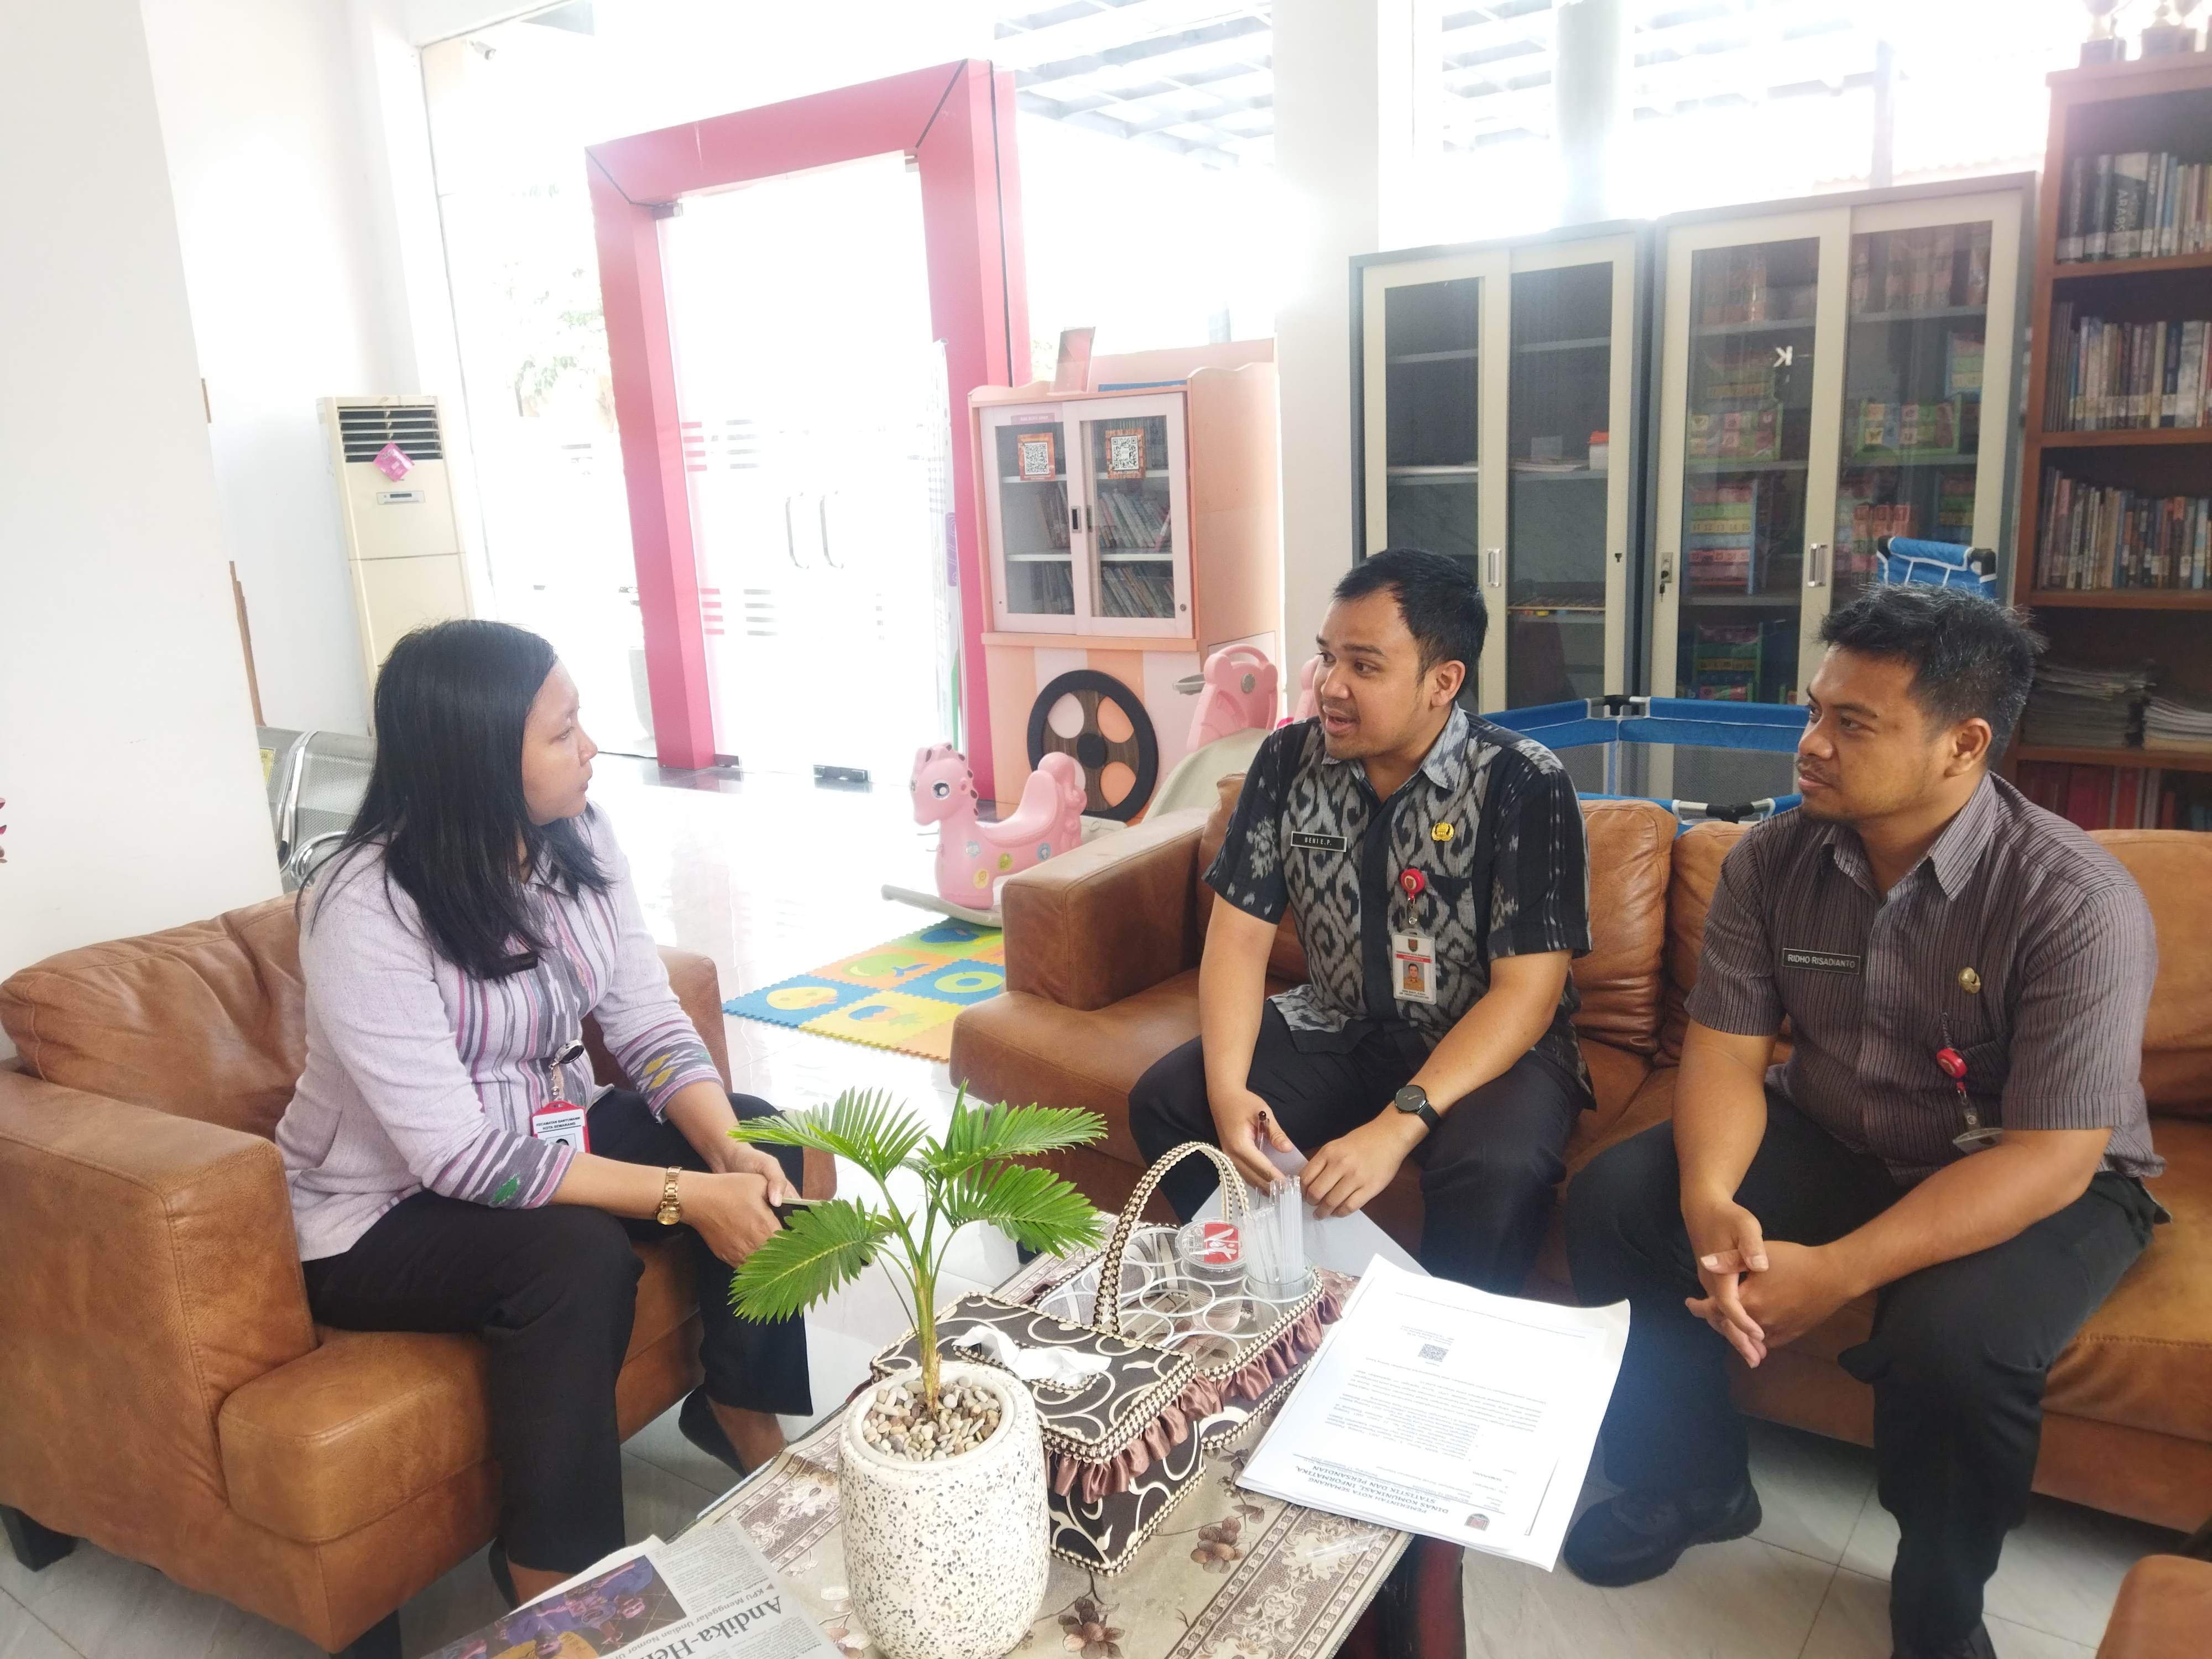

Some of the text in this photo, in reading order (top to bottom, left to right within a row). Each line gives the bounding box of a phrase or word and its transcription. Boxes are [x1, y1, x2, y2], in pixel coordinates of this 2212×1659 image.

[1787, 954, 1855, 968] RIDHO RISADIANTO
[1312, 1465, 1367, 1484] PERSANDIAN
[1370, 1481, 1387, 1490] DAN
[1308, 1477, 1427, 1514] PEMERINTAH KOTA SEMARANG
[1390, 1488, 1437, 1504] STATISTIK
[1420, 1503, 1449, 1514] DINAS
[745, 1588, 765, 1602] KPU
[696, 1595, 744, 1623] Menggelar
[662, 1620, 695, 1638] Undian
[627, 1635, 660, 1654] Nomor
